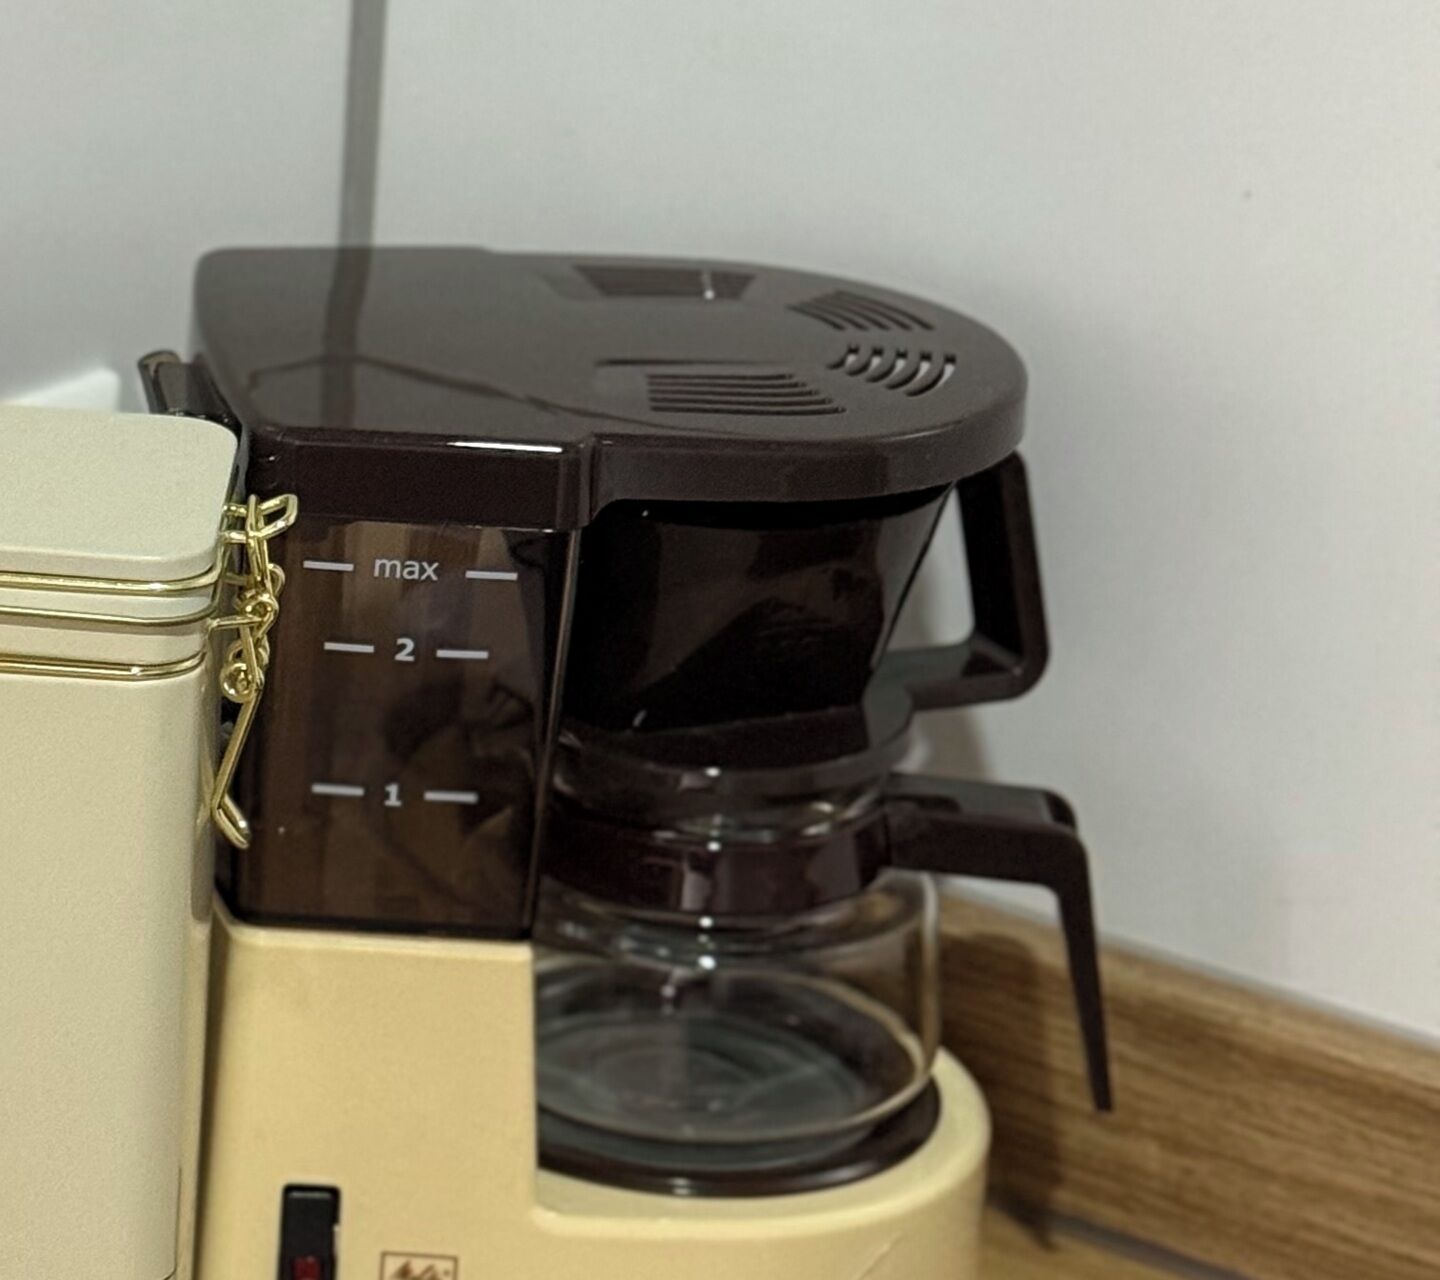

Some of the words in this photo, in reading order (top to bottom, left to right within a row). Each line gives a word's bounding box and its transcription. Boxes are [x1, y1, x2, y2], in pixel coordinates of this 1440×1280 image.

[373, 557, 439, 581] max
[394, 637, 416, 662] 2
[383, 782, 403, 807] 1
